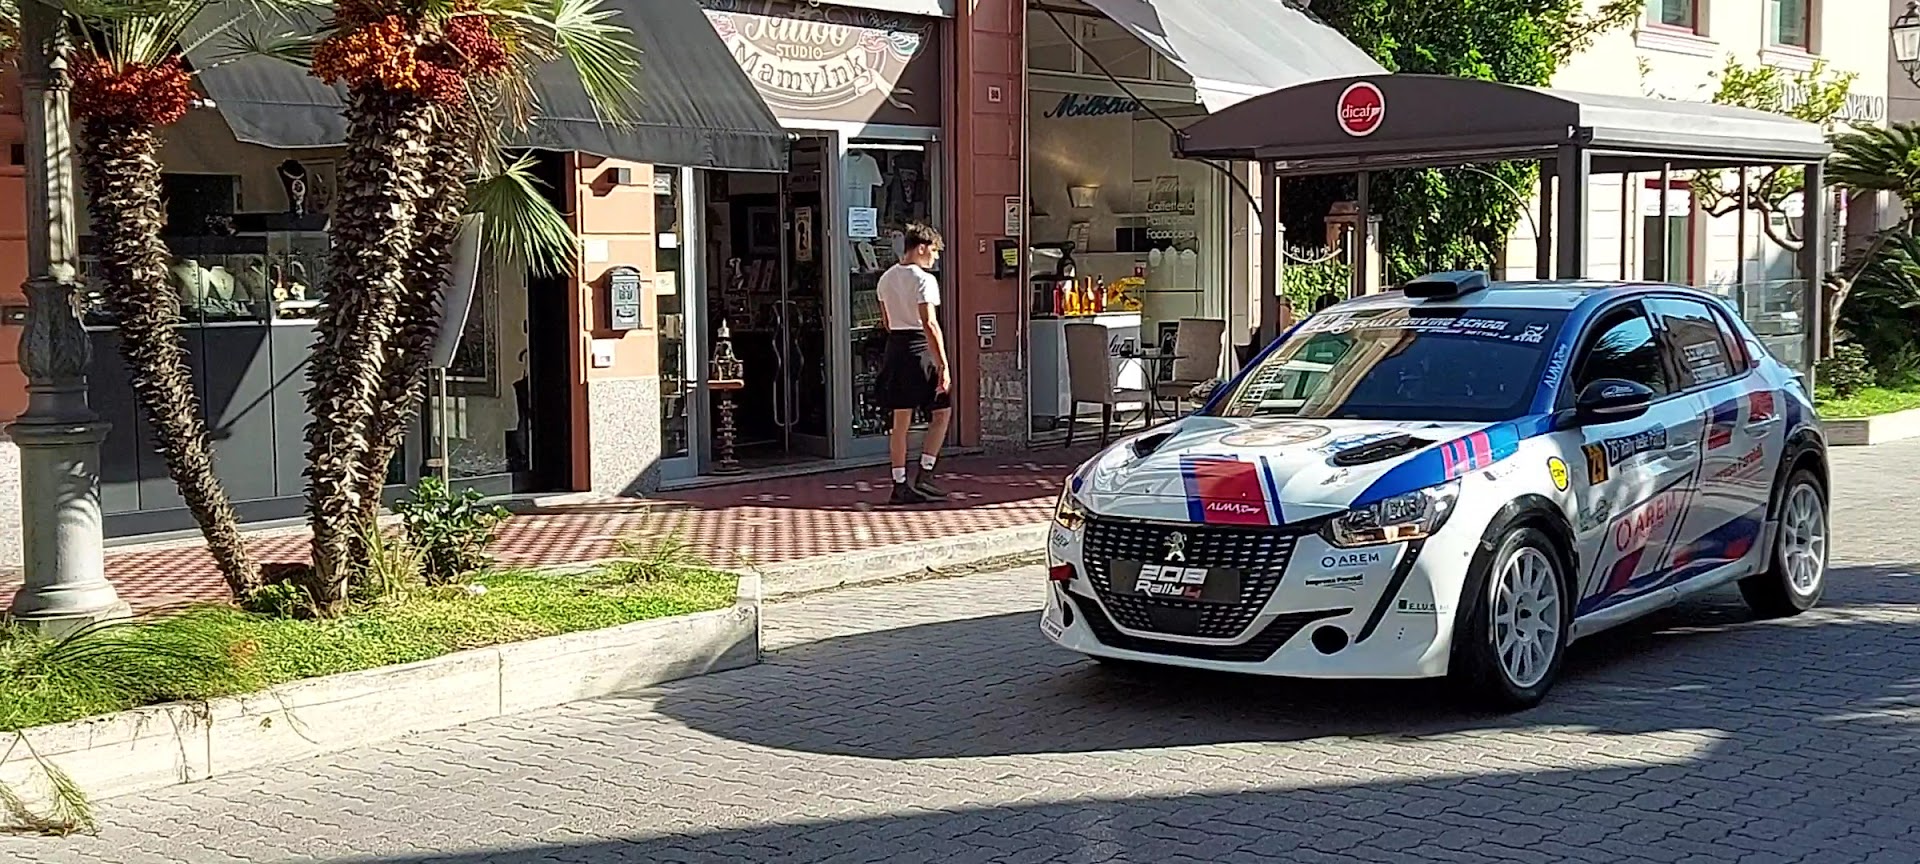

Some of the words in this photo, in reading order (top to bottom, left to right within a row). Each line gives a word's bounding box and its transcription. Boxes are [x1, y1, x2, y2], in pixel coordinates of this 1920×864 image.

[776, 44, 823, 60] STUDIO
[1355, 319, 1397, 329] RALLY
[1452, 318, 1509, 331] SCHOOL
[1337, 552, 1380, 564] AREM
[1138, 564, 1208, 585] 208
